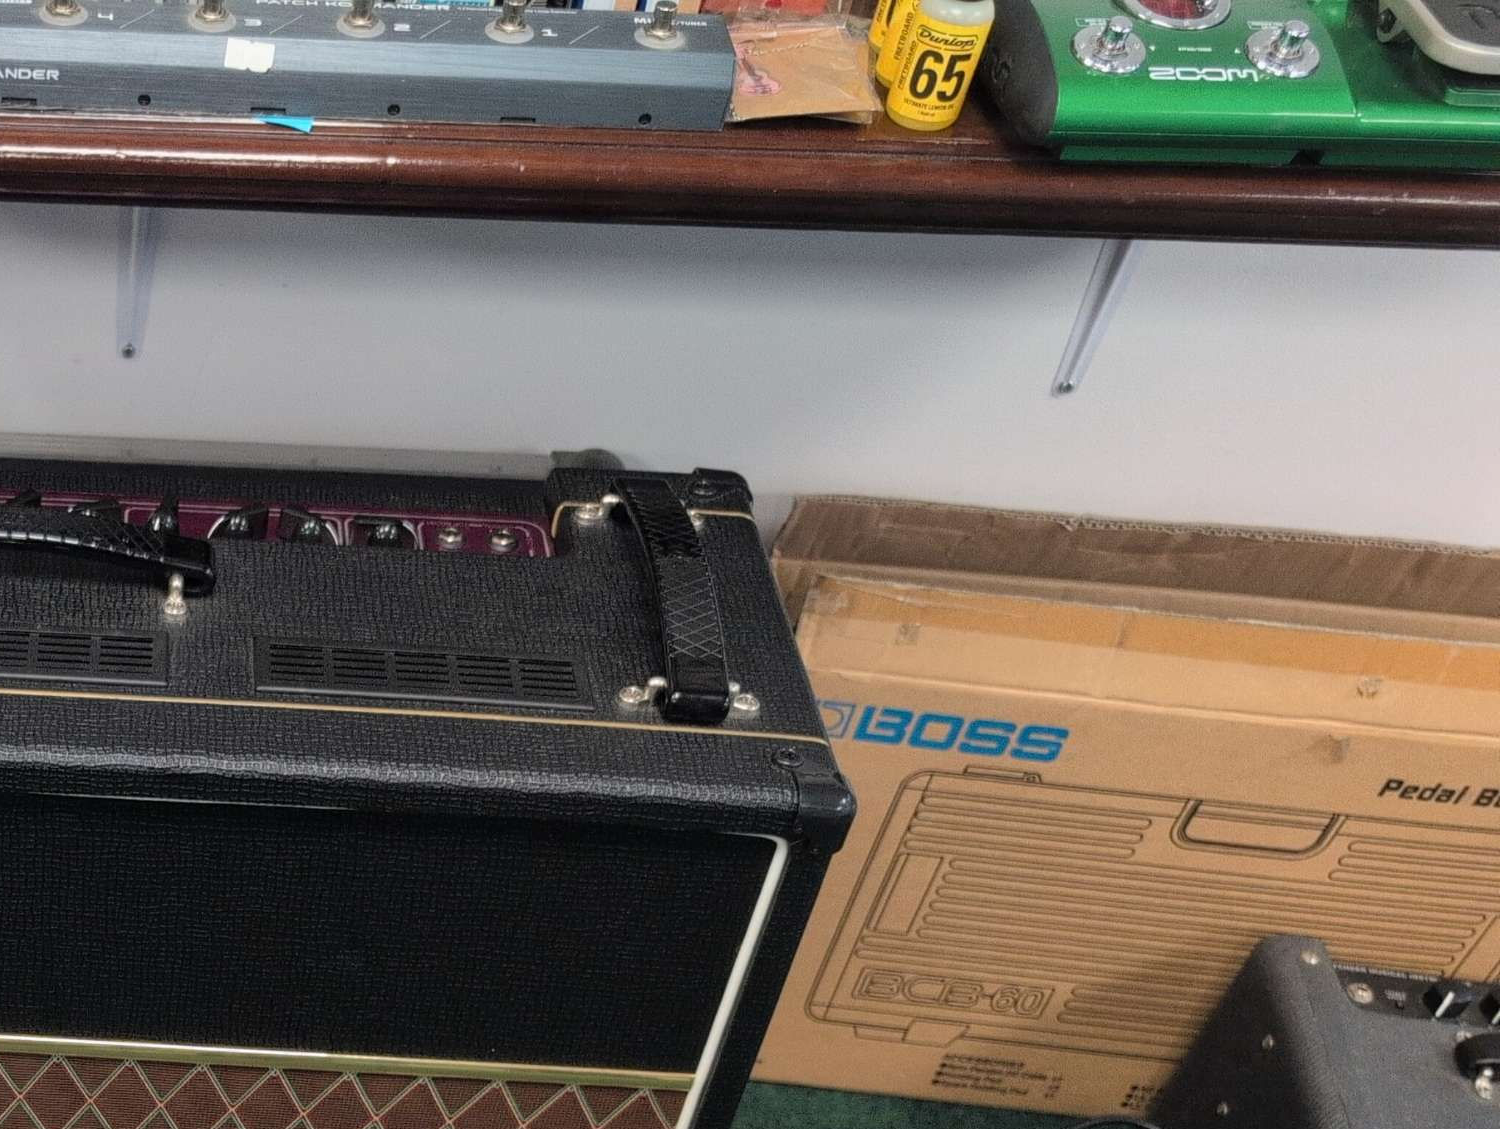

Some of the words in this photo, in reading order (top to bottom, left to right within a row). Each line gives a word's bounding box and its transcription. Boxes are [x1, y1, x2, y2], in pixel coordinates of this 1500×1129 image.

[920, 28, 975, 48] Dunlop
[909, 49, 972, 103] 65
[1148, 66, 1259, 82] ZOOM
[853, 705, 1070, 763] BOSS
[1377, 778, 1470, 805] Pedal
[857, 970, 1048, 1018] BCB-60
